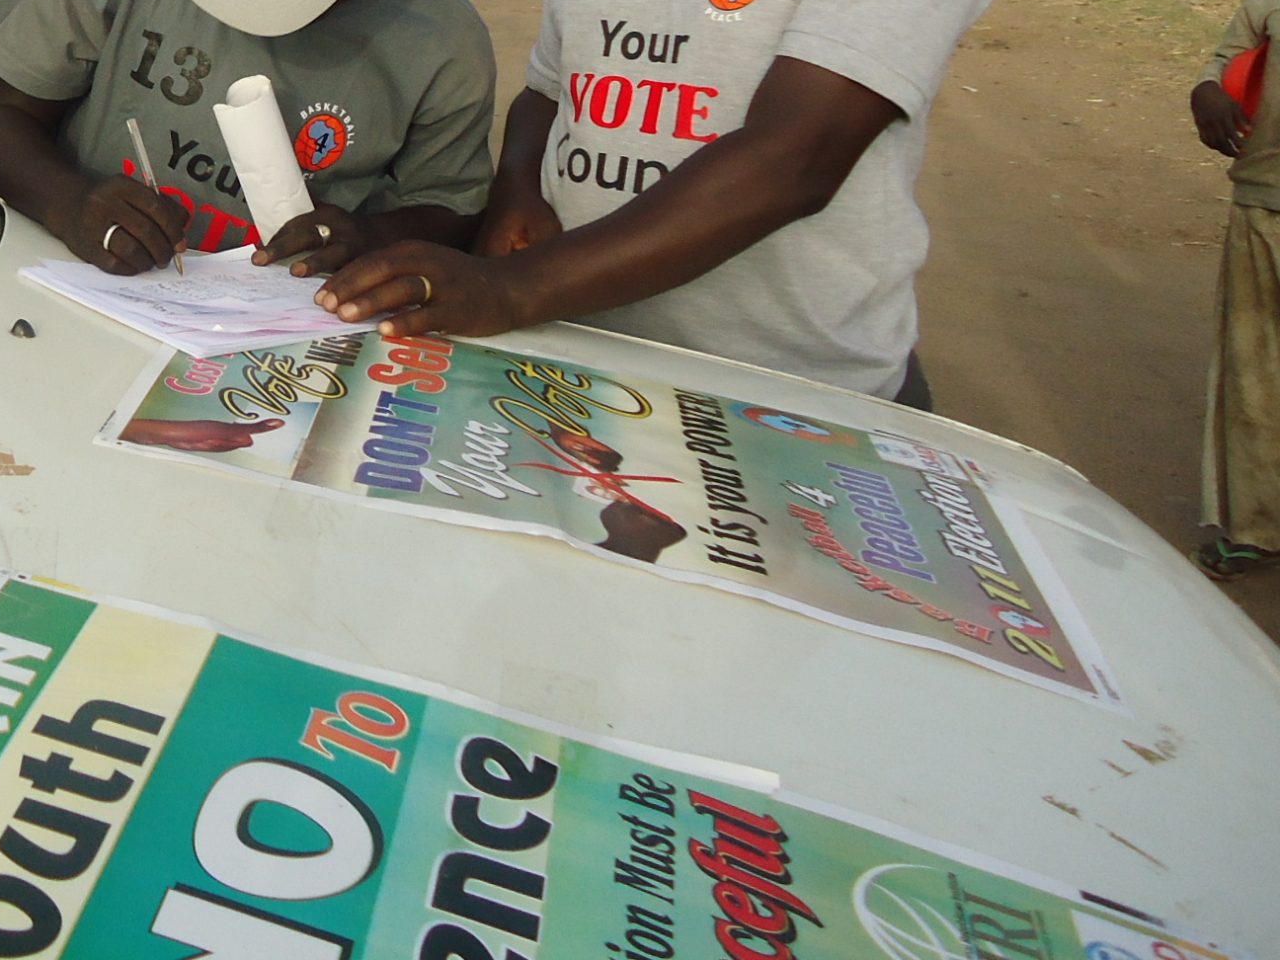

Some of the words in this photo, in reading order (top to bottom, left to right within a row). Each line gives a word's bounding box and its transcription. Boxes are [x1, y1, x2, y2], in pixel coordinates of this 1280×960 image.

[600, 19, 690, 64] Your
[705, 7, 744, 23] PEACE
[130, 29, 212, 106] 13
[300, 102, 355, 147] BASKETBALL
[314, 132, 329, 154] 4
[570, 72, 719, 144] VOTE
[168, 129, 248, 203] You
[556, 132, 672, 194] Coun
[219, 350, 349, 421] Vote
[353, 390, 441, 493] DON'T
[421, 420, 543, 500] Your
[490, 357, 654, 439] Vote
[698, 457, 769, 526] your
[778, 479, 838, 509] 4
[824, 460, 937, 585] Peaceful
[917, 470, 1008, 575] Election
[696, 516, 761, 547] is
[704, 543, 769, 577] It
[618, 772, 677, 818] Be
[614, 811, 677, 907] Must
[686, 787, 825, 960] ceful
